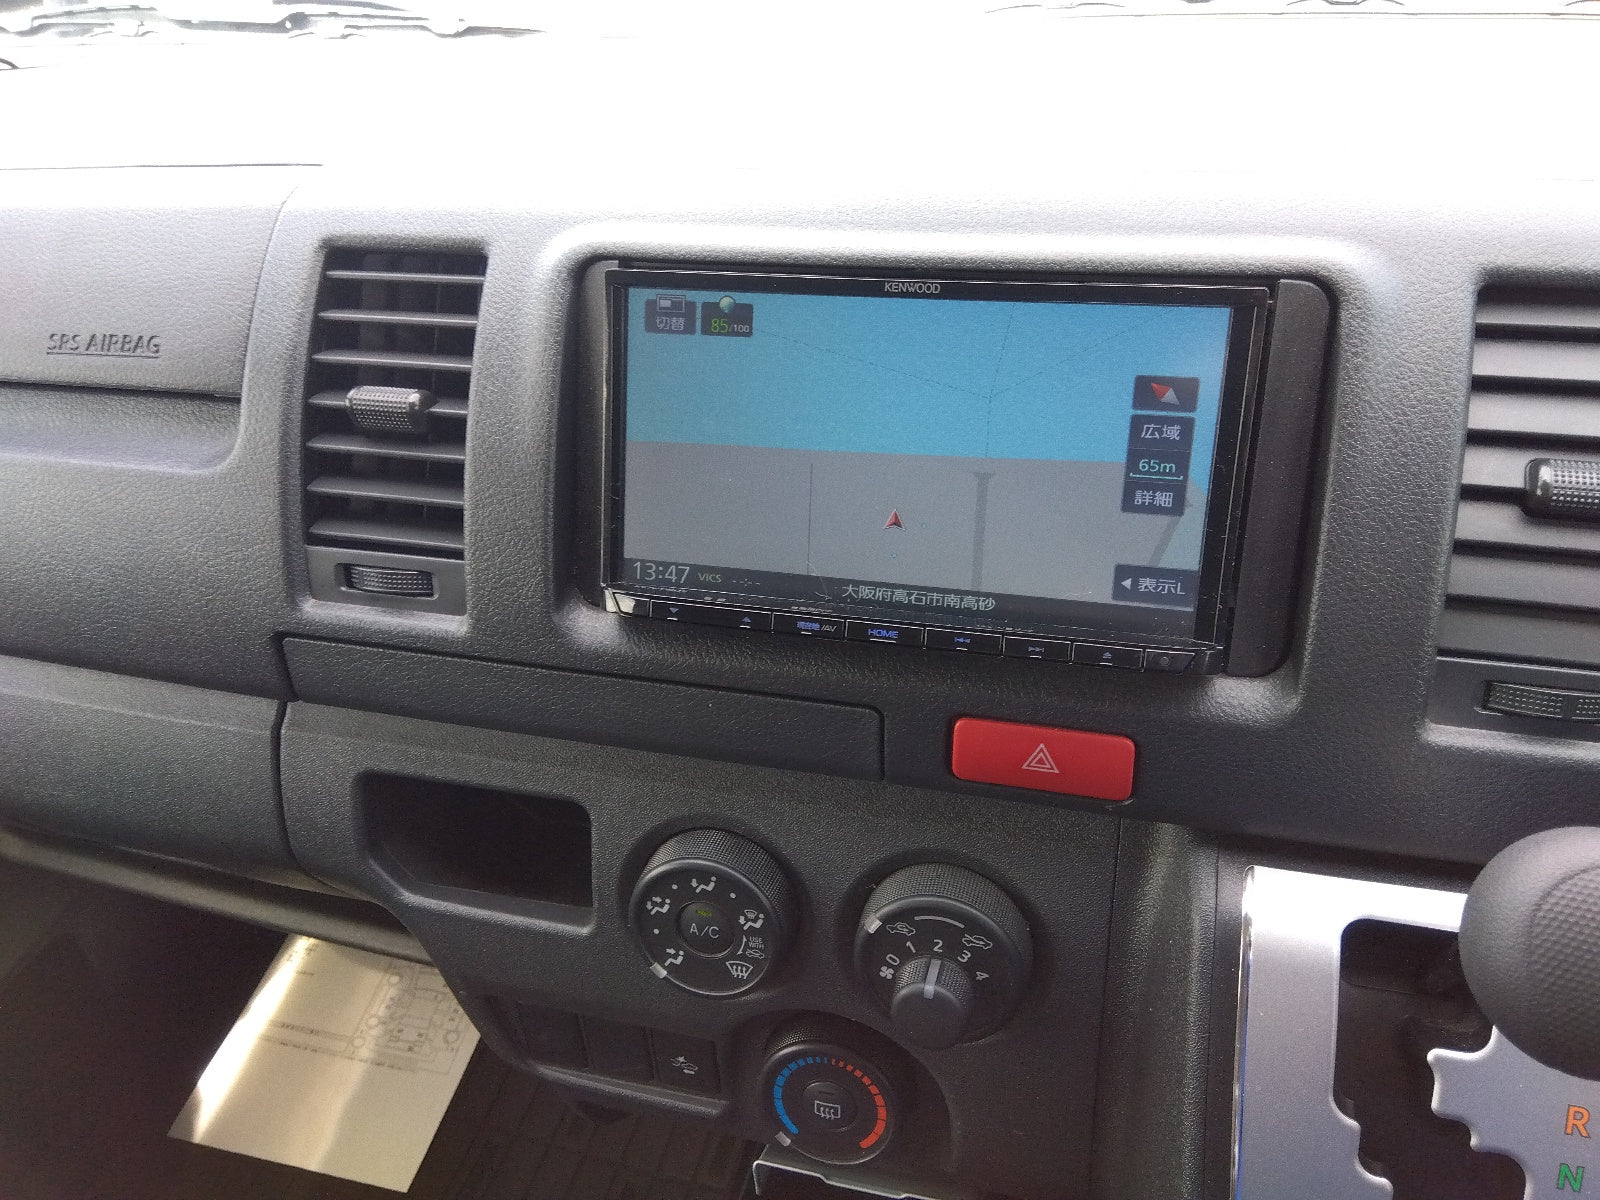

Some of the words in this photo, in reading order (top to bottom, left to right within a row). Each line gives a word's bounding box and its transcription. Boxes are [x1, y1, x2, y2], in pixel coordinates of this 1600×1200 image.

[884, 281, 941, 295] KENWOOD
[655, 316, 685, 331] 切替
[84, 333, 161, 354] AIRBAG
[1141, 423, 1182, 441] 広域
[1138, 458, 1176, 474] 65m
[1134, 489, 1174, 508] 詳細
[632, 561, 690, 584] 13:47
[697, 572, 722, 583] VICS
[1137, 577, 1185, 596] 表示L
[842, 584, 996, 611] 大阪府高石市南高砂
[868, 628, 899, 639] HOME
[689, 923, 720, 939] A/C
[905, 940, 917, 954] 1
[933, 939, 943, 953] 2
[957, 949, 972, 963] 3
[975, 970, 990, 981] 4
[1564, 1104, 1591, 1139] R
[1557, 1162, 1585, 1193] N
